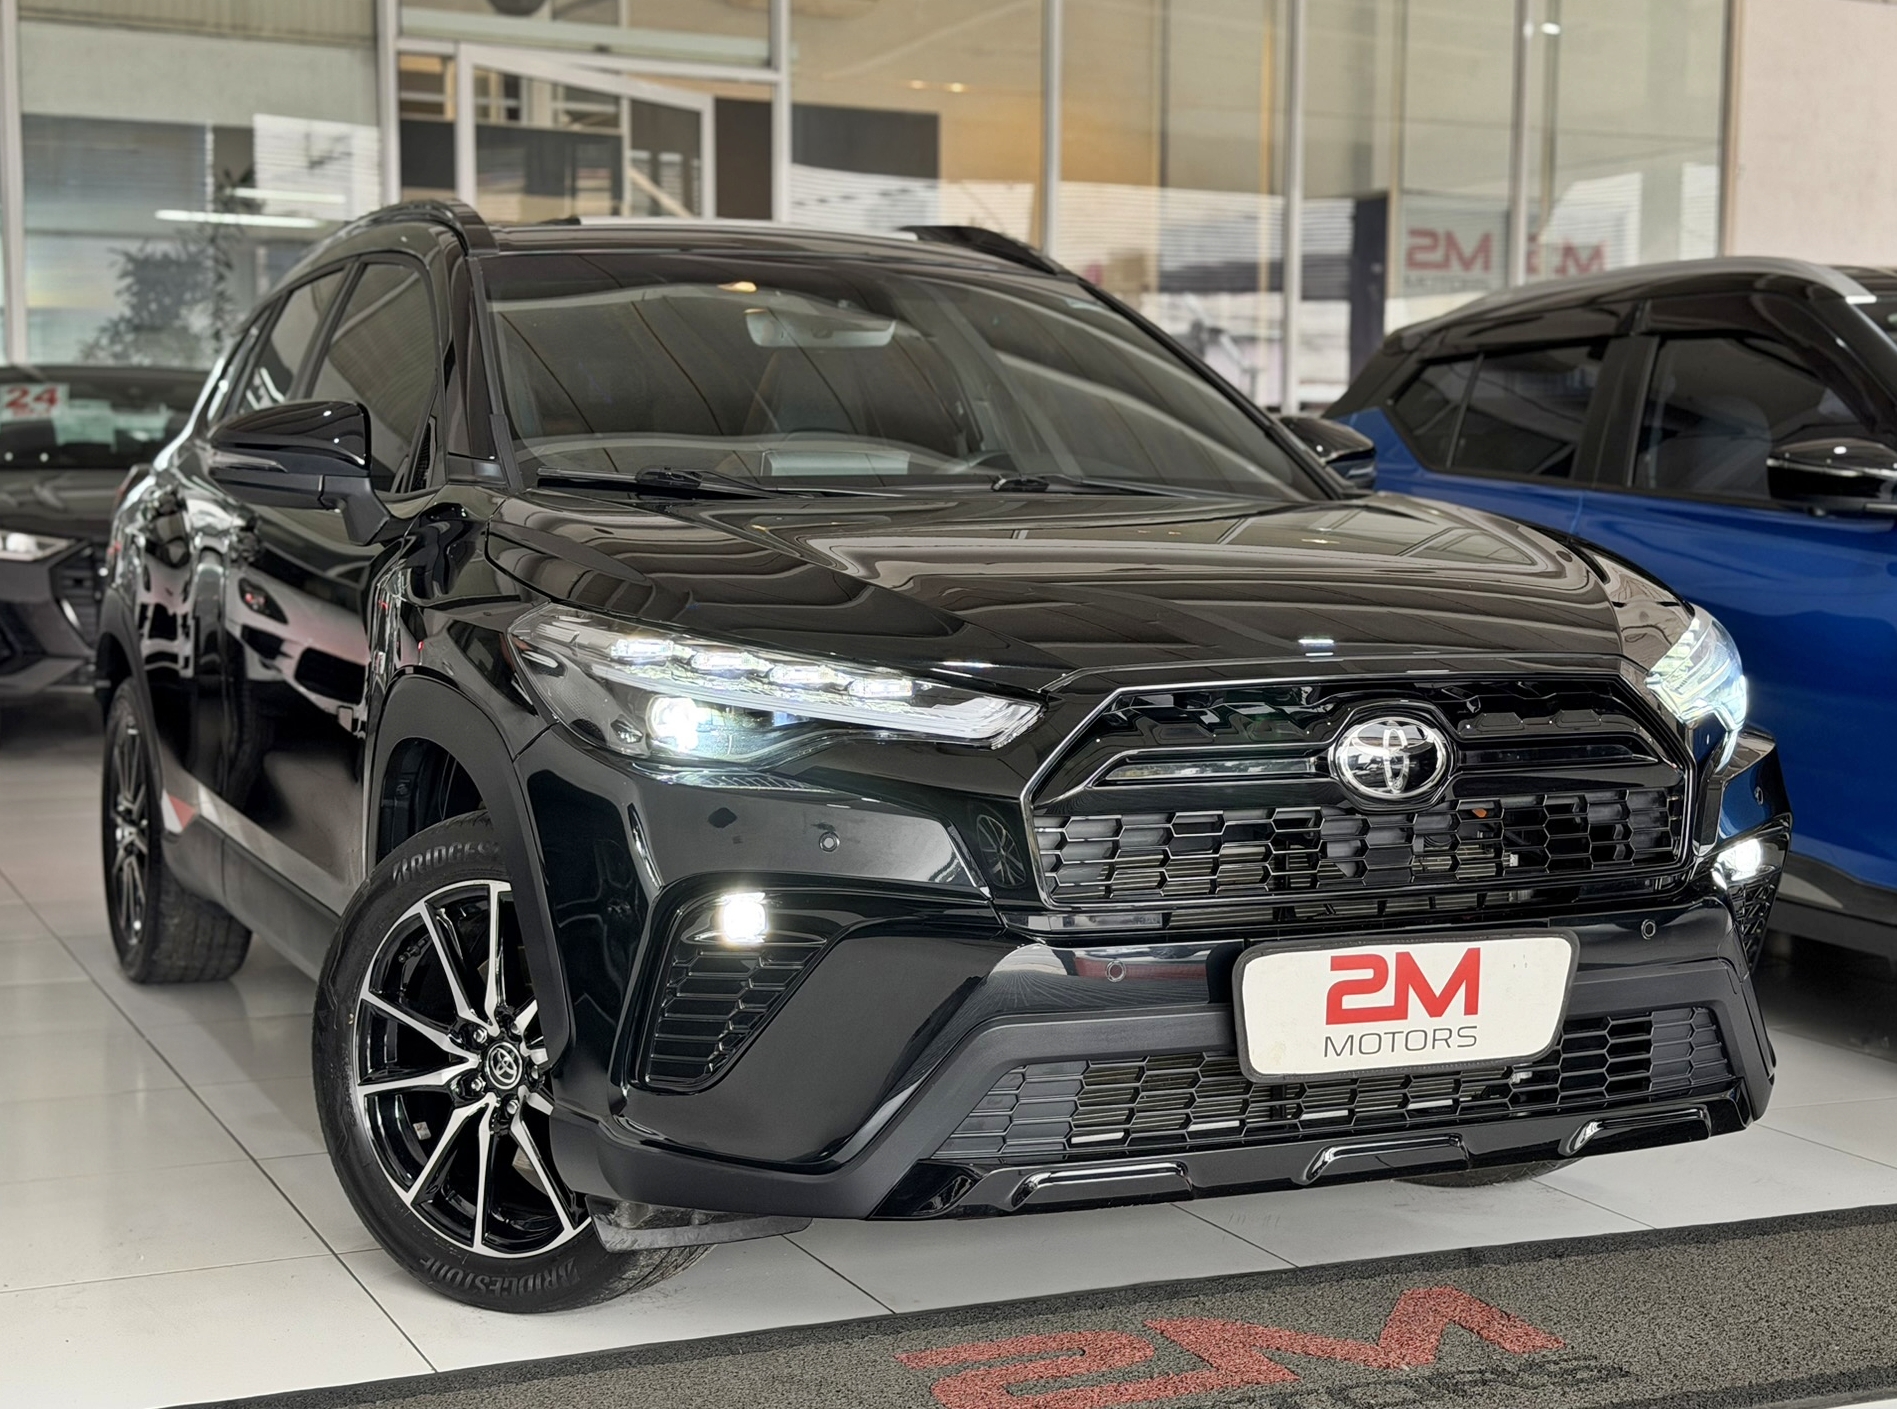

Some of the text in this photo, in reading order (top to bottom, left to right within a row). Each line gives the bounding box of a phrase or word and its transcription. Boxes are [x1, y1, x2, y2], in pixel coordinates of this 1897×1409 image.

[1406, 228, 1493, 273] 2M
[5, 387, 59, 408] 24
[1325, 947, 1481, 1026] 2M
[1323, 1025, 1479, 1058] MOTORS
[894, 1286, 1567, 1409] 2M
